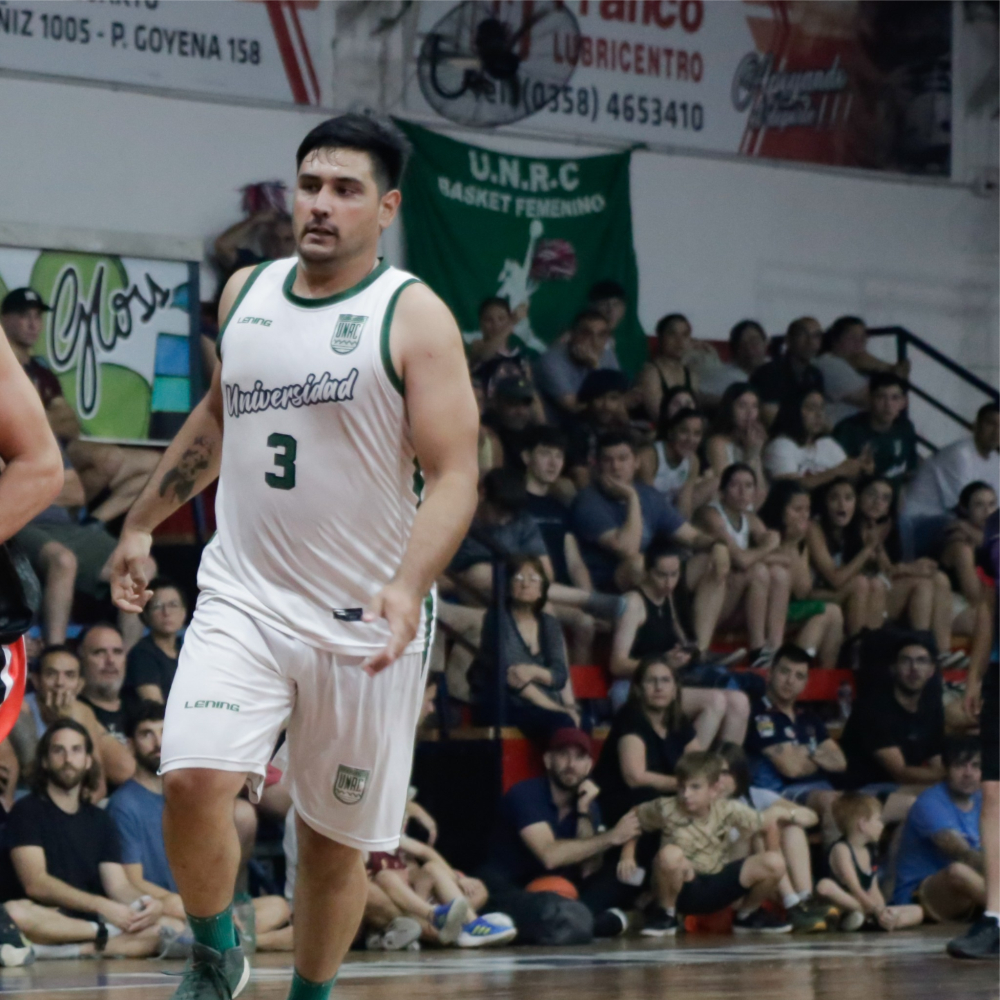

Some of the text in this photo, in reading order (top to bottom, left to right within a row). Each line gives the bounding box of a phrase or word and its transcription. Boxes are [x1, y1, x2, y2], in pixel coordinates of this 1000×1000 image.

[40, 14, 91, 44] 1005
[110, 22, 127, 49] P.
[134, 25, 222, 61] GOYENA
[228, 37, 262, 66] 158
[552, 30, 705, 83] LUBRICENTRO
[605, 91, 706, 132] 4653410
[437, 172, 606, 218] BASKET FEMENINO
[224, 366, 361, 419] Universidad
[264, 431, 298, 491] 3
